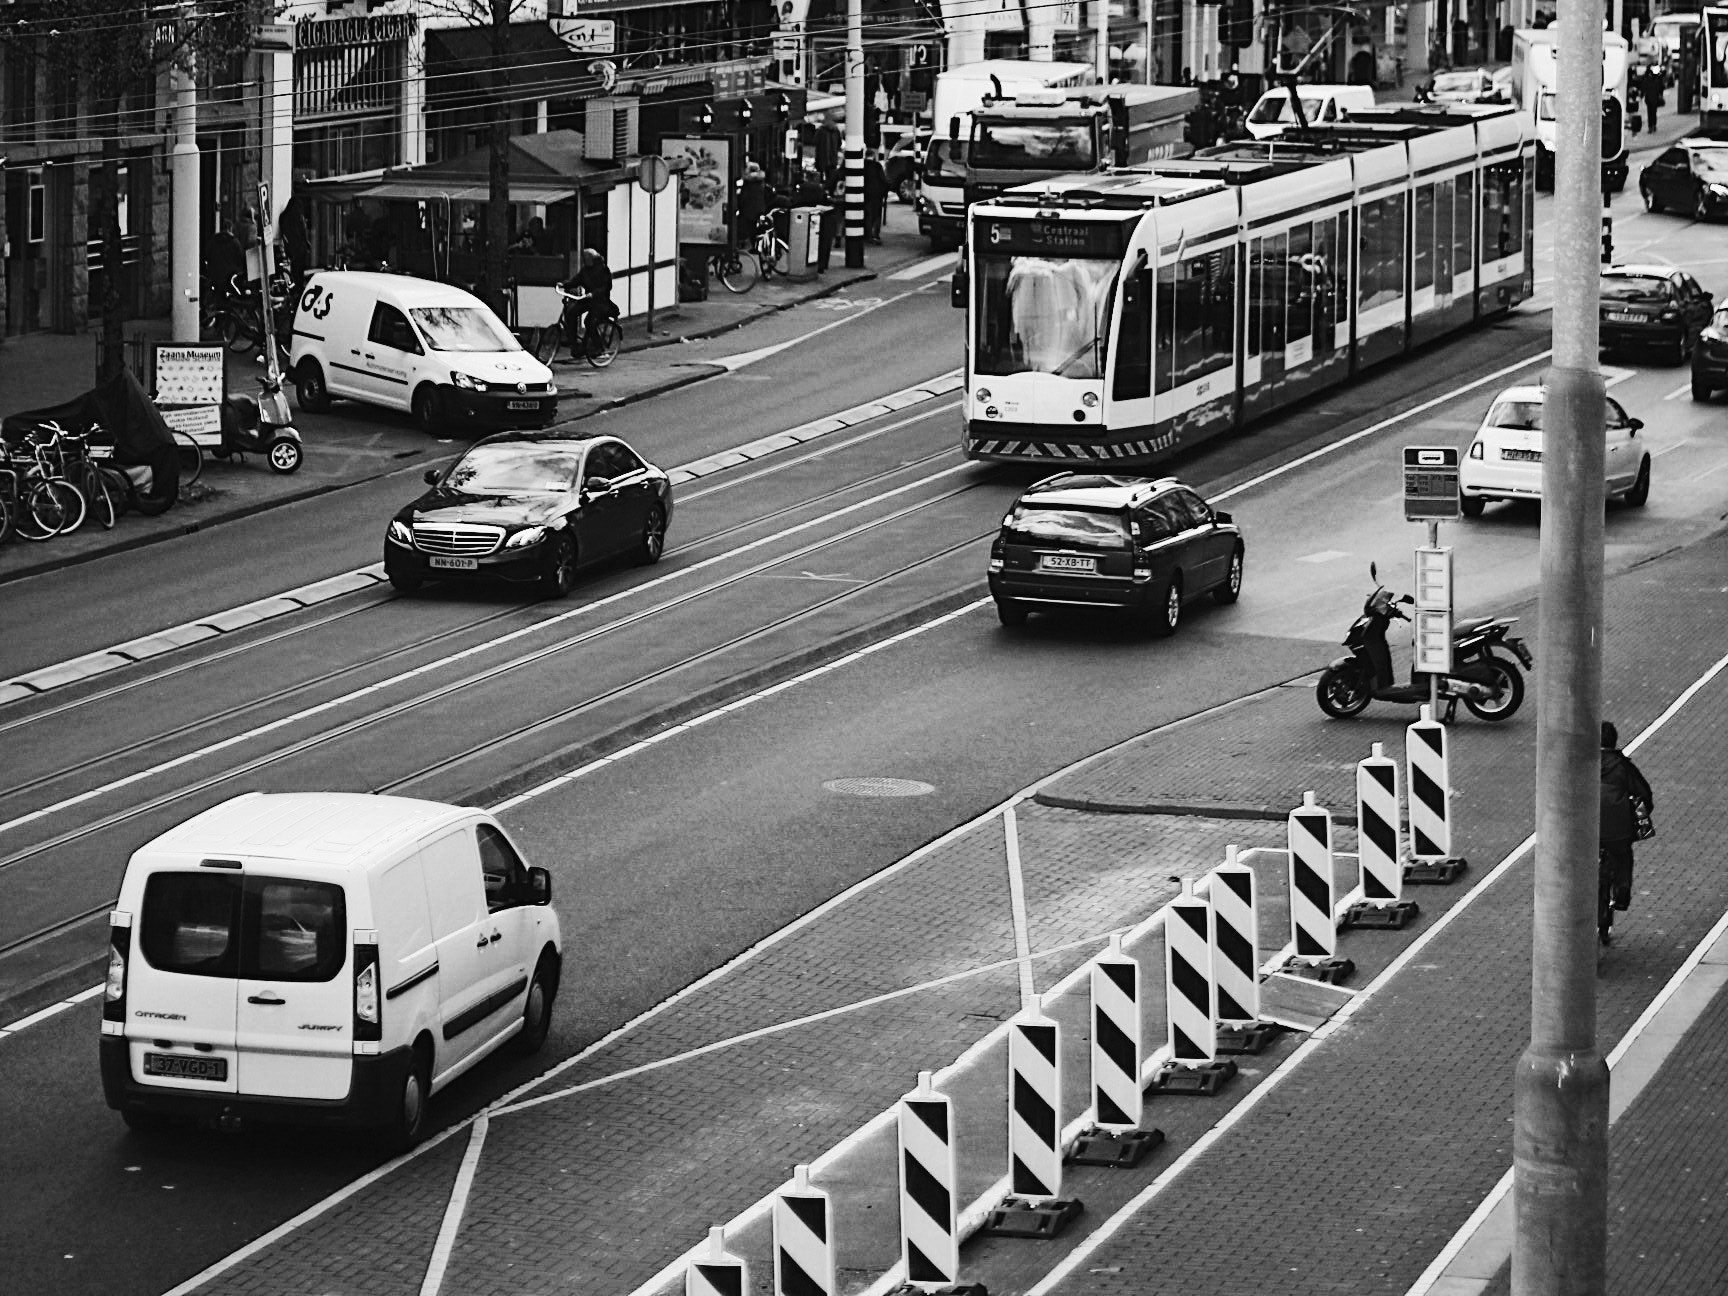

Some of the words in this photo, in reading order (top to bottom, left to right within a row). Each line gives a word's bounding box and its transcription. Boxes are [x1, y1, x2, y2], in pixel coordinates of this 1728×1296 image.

[299, 20, 369, 47] CIGARAGUA
[374, 13, 419, 40] CIGARS
[990, 223, 1000, 244] 5
[1043, 225, 1089, 236] Centraal
[1046, 236, 1085, 246] Station
[301, 284, 334, 320] G4S
[1050, 556, 1091, 567] 52-XB-TT
[157, 1057, 221, 1077] 37-VGD-1
